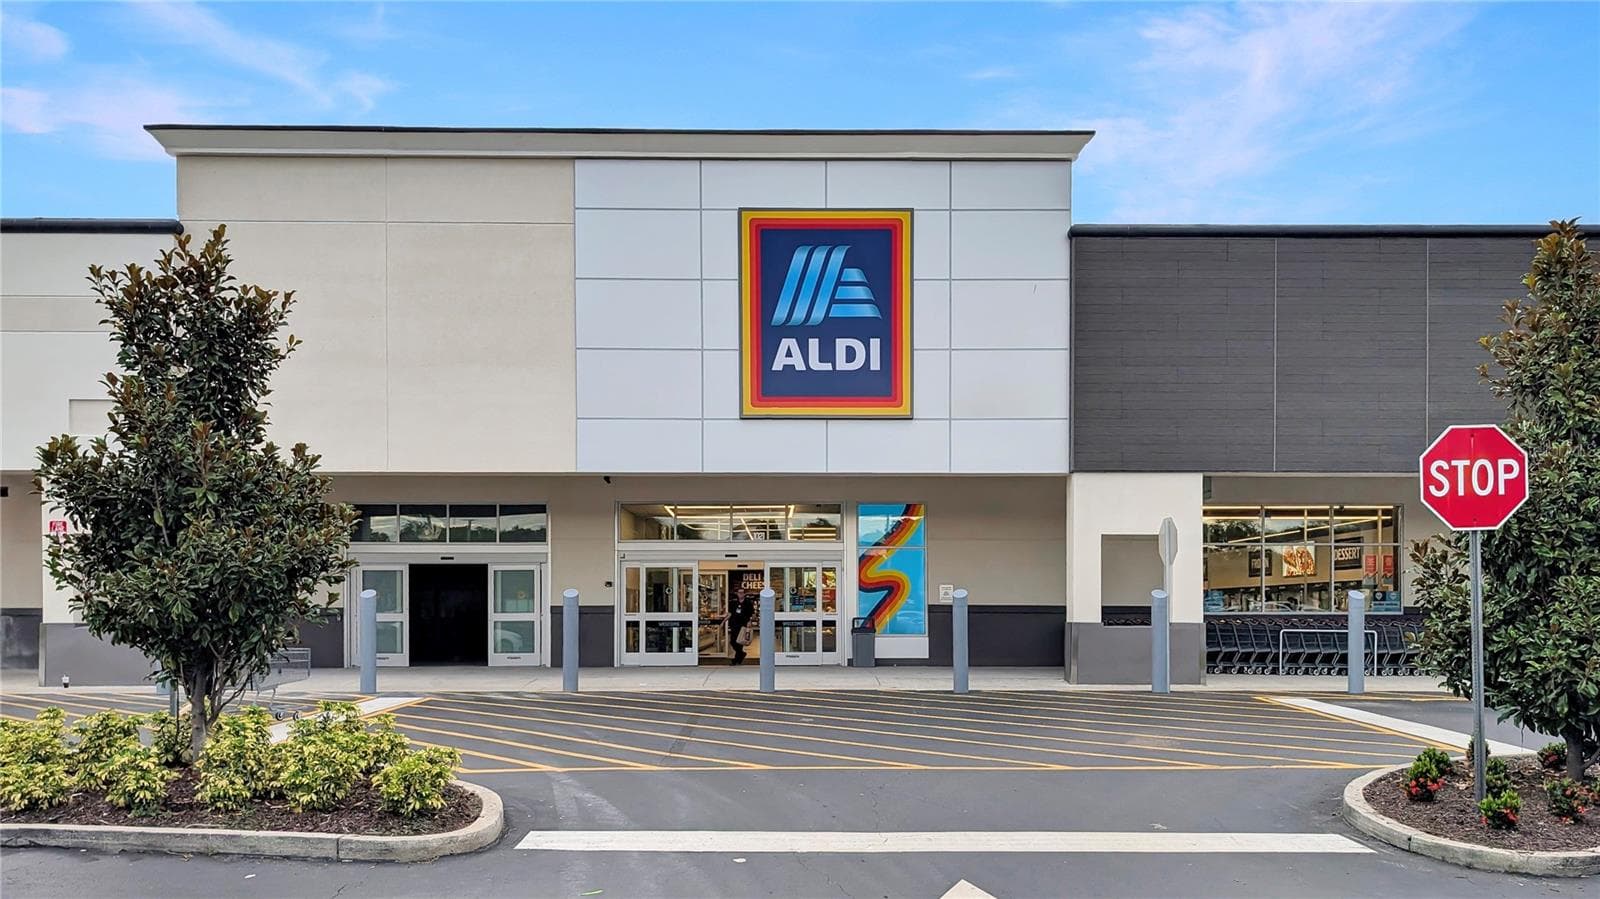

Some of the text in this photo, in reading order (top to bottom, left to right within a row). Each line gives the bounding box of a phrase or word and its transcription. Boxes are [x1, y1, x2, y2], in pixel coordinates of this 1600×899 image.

[771, 338, 881, 371] ALDI
[1428, 458, 1520, 498] STOP
[1334, 546, 1361, 561] DESSERT
[742, 573, 761, 582] DELI
